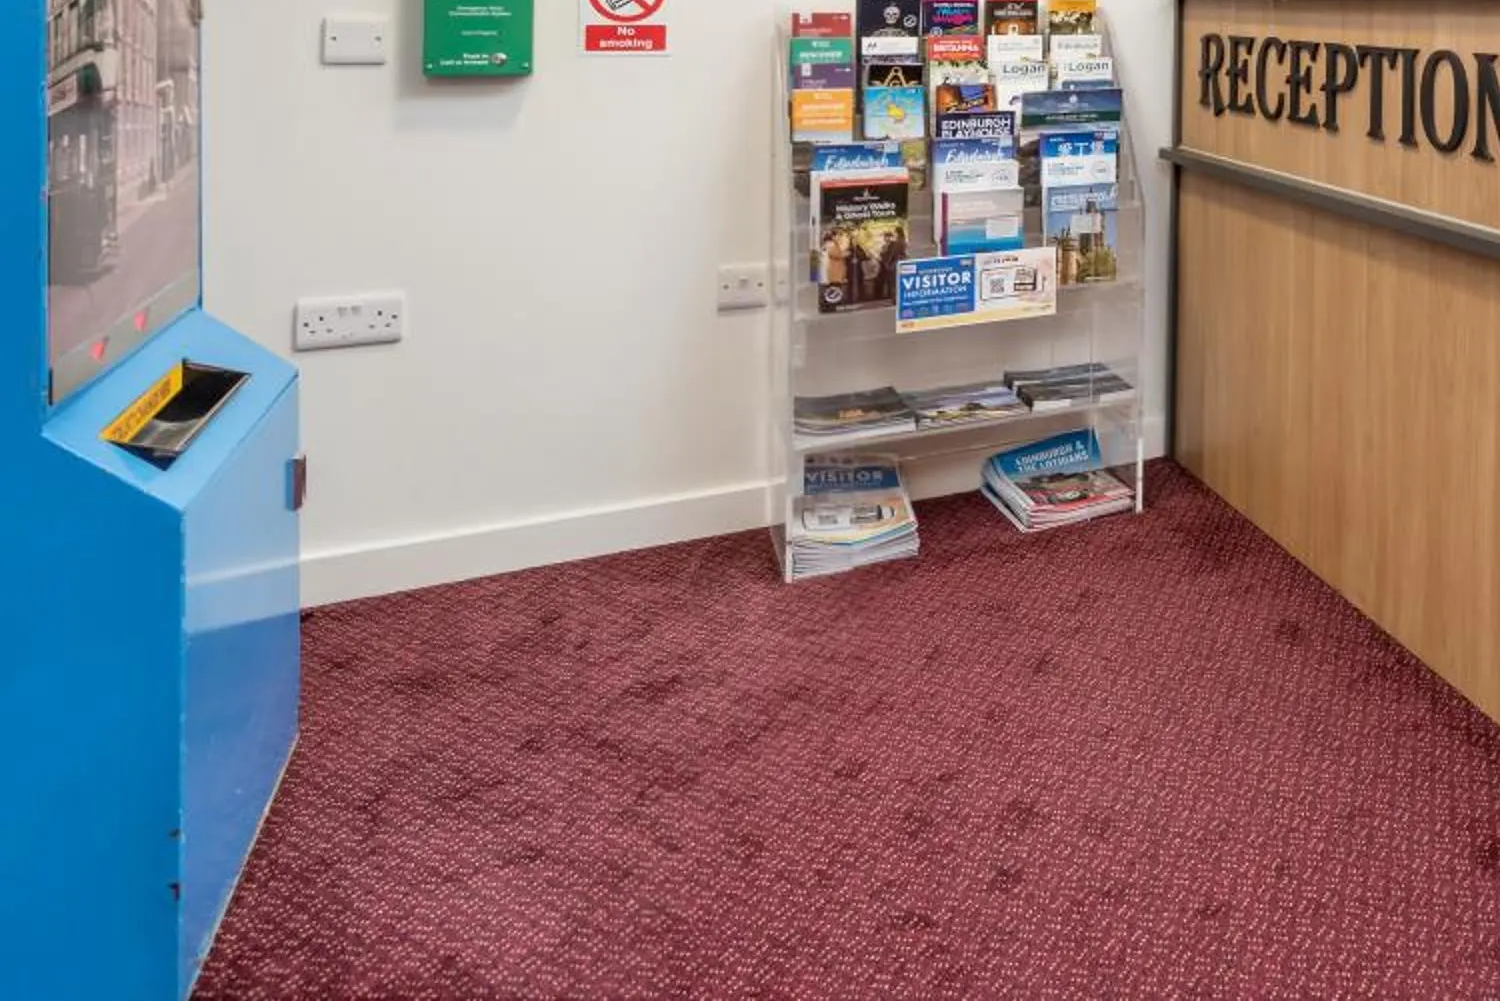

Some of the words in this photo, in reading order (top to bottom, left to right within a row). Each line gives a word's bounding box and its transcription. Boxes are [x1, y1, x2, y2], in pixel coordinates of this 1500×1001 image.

[616, 26, 637, 36] No
[599, 37, 653, 50] smoking
[1003, 62, 1045, 76] Logan
[1068, 61, 1109, 74] Logan
[942, 116, 1011, 130] EDINBURGH
[901, 270, 972, 290] VISITOR
[806, 469, 884, 484] VISITOR
